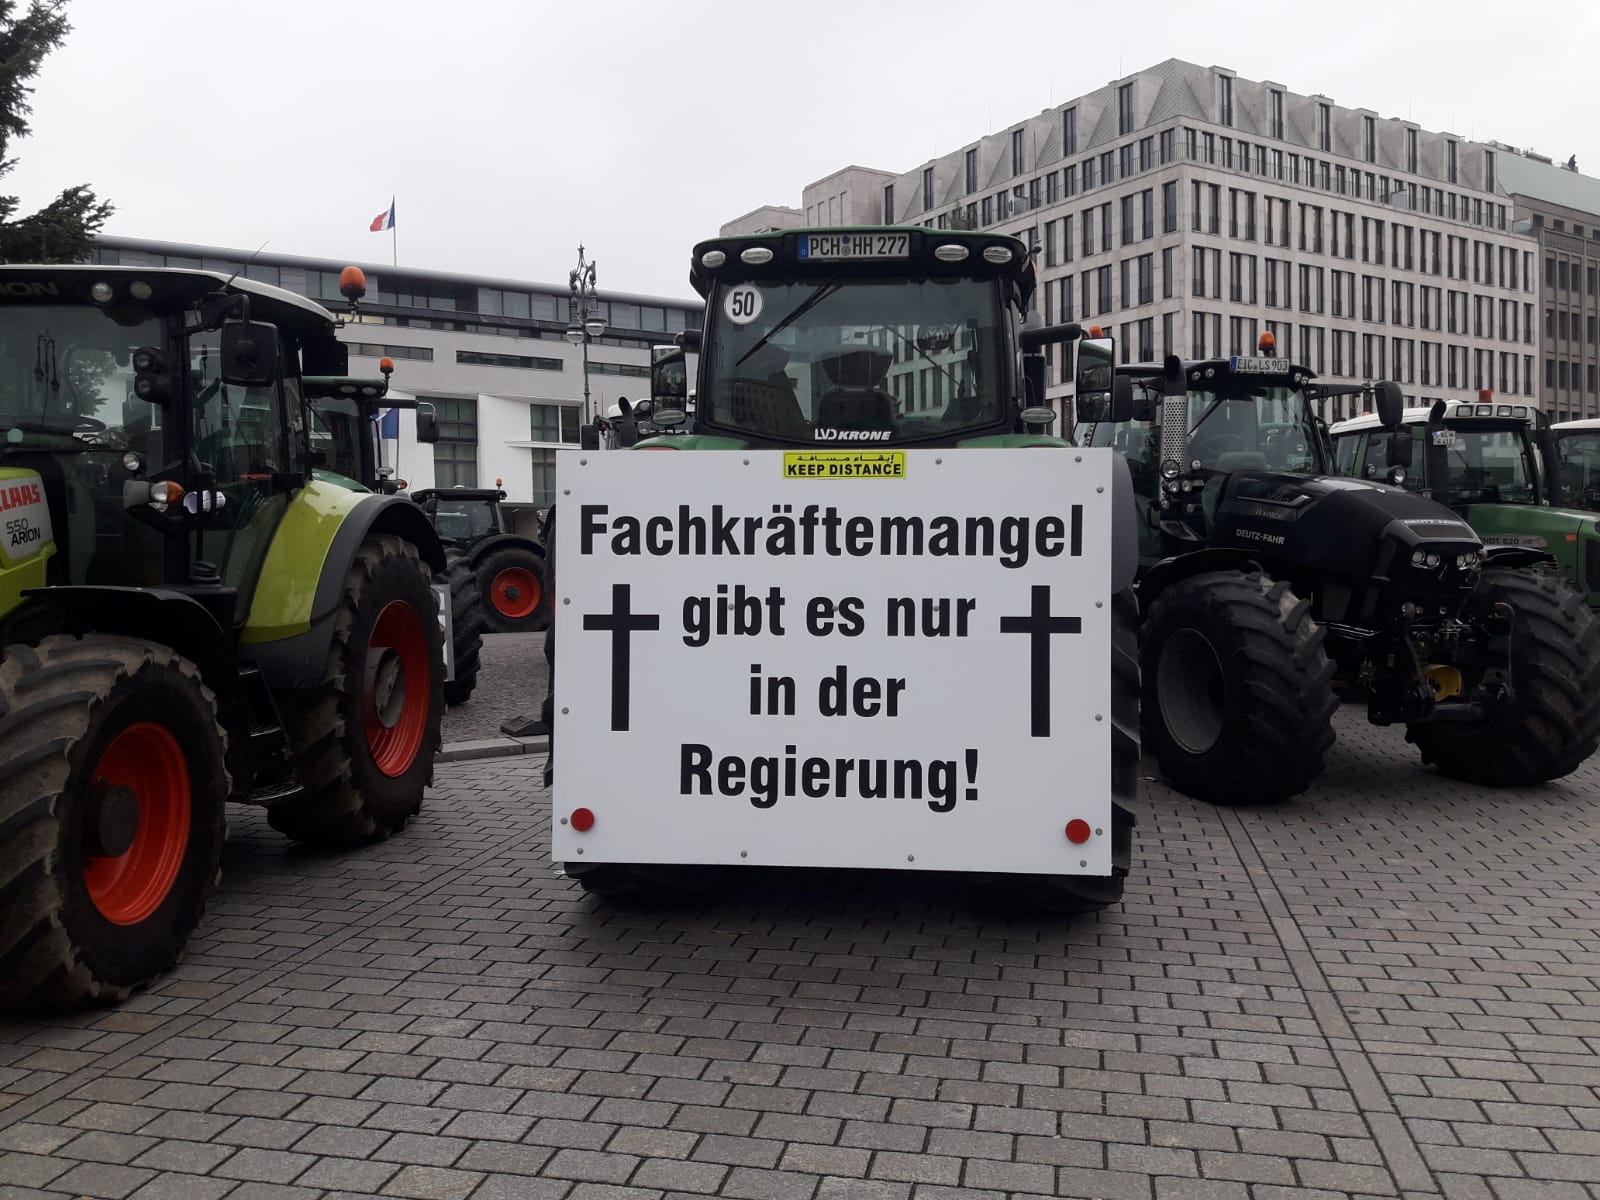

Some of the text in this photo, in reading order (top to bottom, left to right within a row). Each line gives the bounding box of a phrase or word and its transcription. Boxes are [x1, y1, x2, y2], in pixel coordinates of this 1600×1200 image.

[810, 237, 840, 256] PCH
[853, 236, 873, 255] HH
[877, 235, 907, 255] 277
[732, 291, 755, 317] 50
[838, 431, 891, 440] KRONE
[787, 463, 901, 475] KEEP DISTANCE
[0, 484, 41, 512] LAAS
[6, 518, 28, 535] 550
[11, 527, 41, 546] ARION
[580, 504, 1083, 569] Fachkräftemangel
[1235, 528, 1285, 544] DEUTZ-FAHR
[682, 584, 976, 648] gibt es nur
[750, 663, 906, 718] in der
[680, 743, 978, 813] Regierung!
